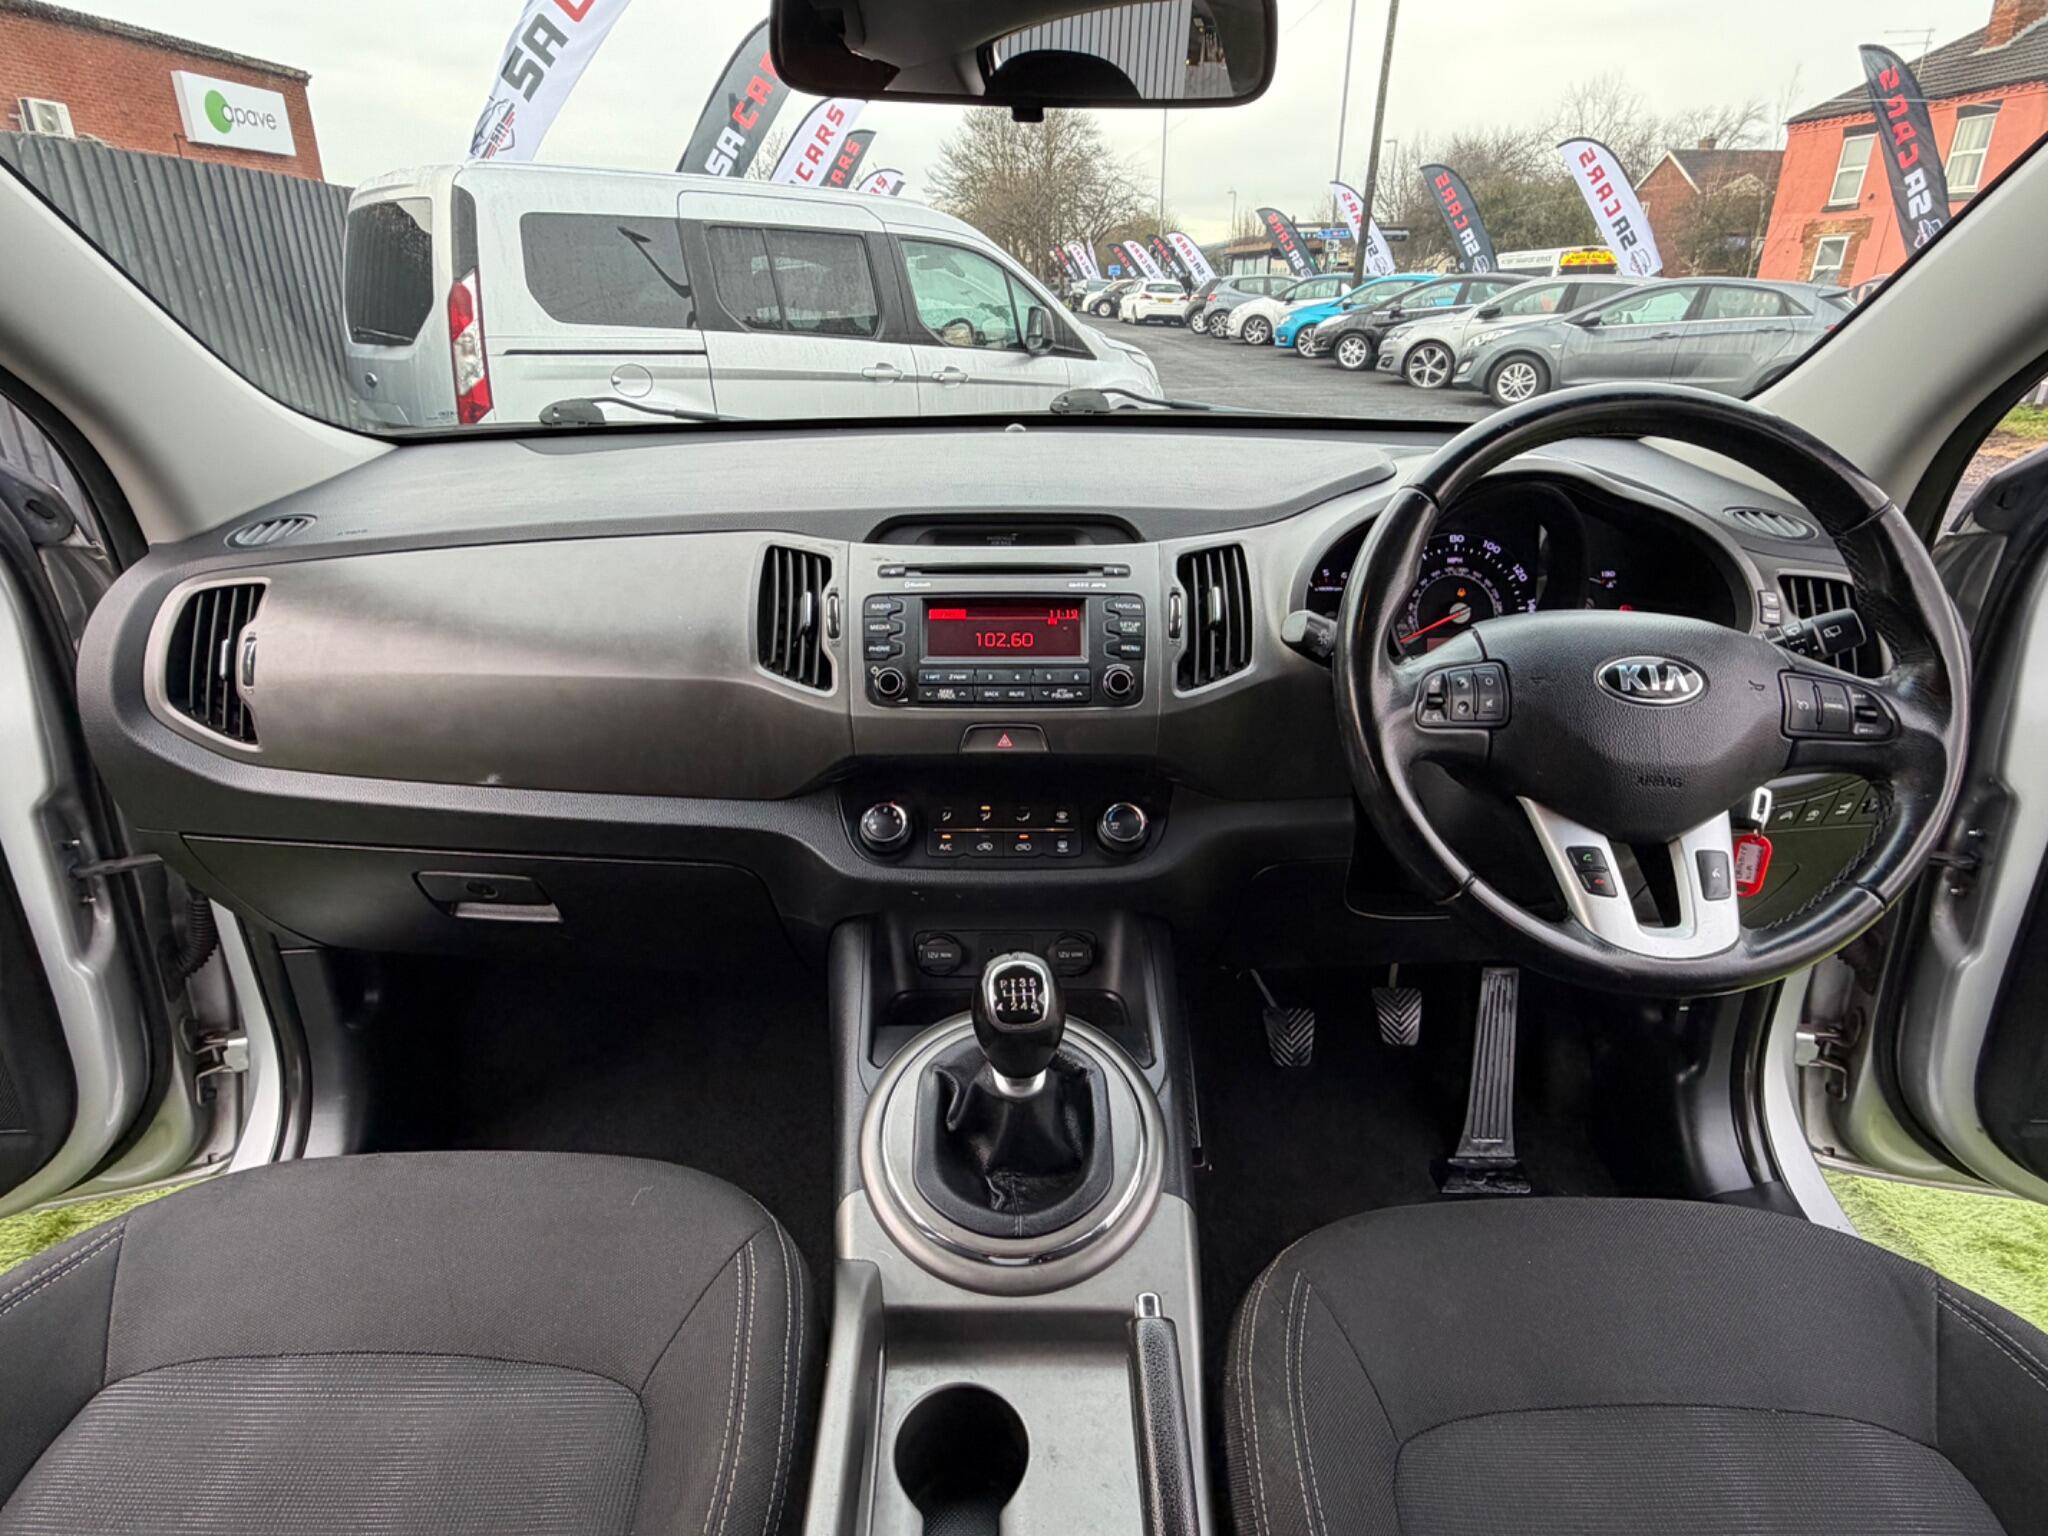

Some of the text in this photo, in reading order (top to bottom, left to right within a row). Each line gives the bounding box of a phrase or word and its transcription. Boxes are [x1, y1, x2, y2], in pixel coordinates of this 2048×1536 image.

[221, 104, 278, 130] apave
[795, 104, 845, 183] CARS
[827, 139, 861, 187] ARS
[1449, 534, 1465, 543] 80
[1482, 540, 1501, 554] 100
[1512, 563, 1529, 583] 120
[868, 645, 891, 653] PHONE
[975, 632, 1034, 648] 102.60
[1616, 664, 1691, 692] KIA
